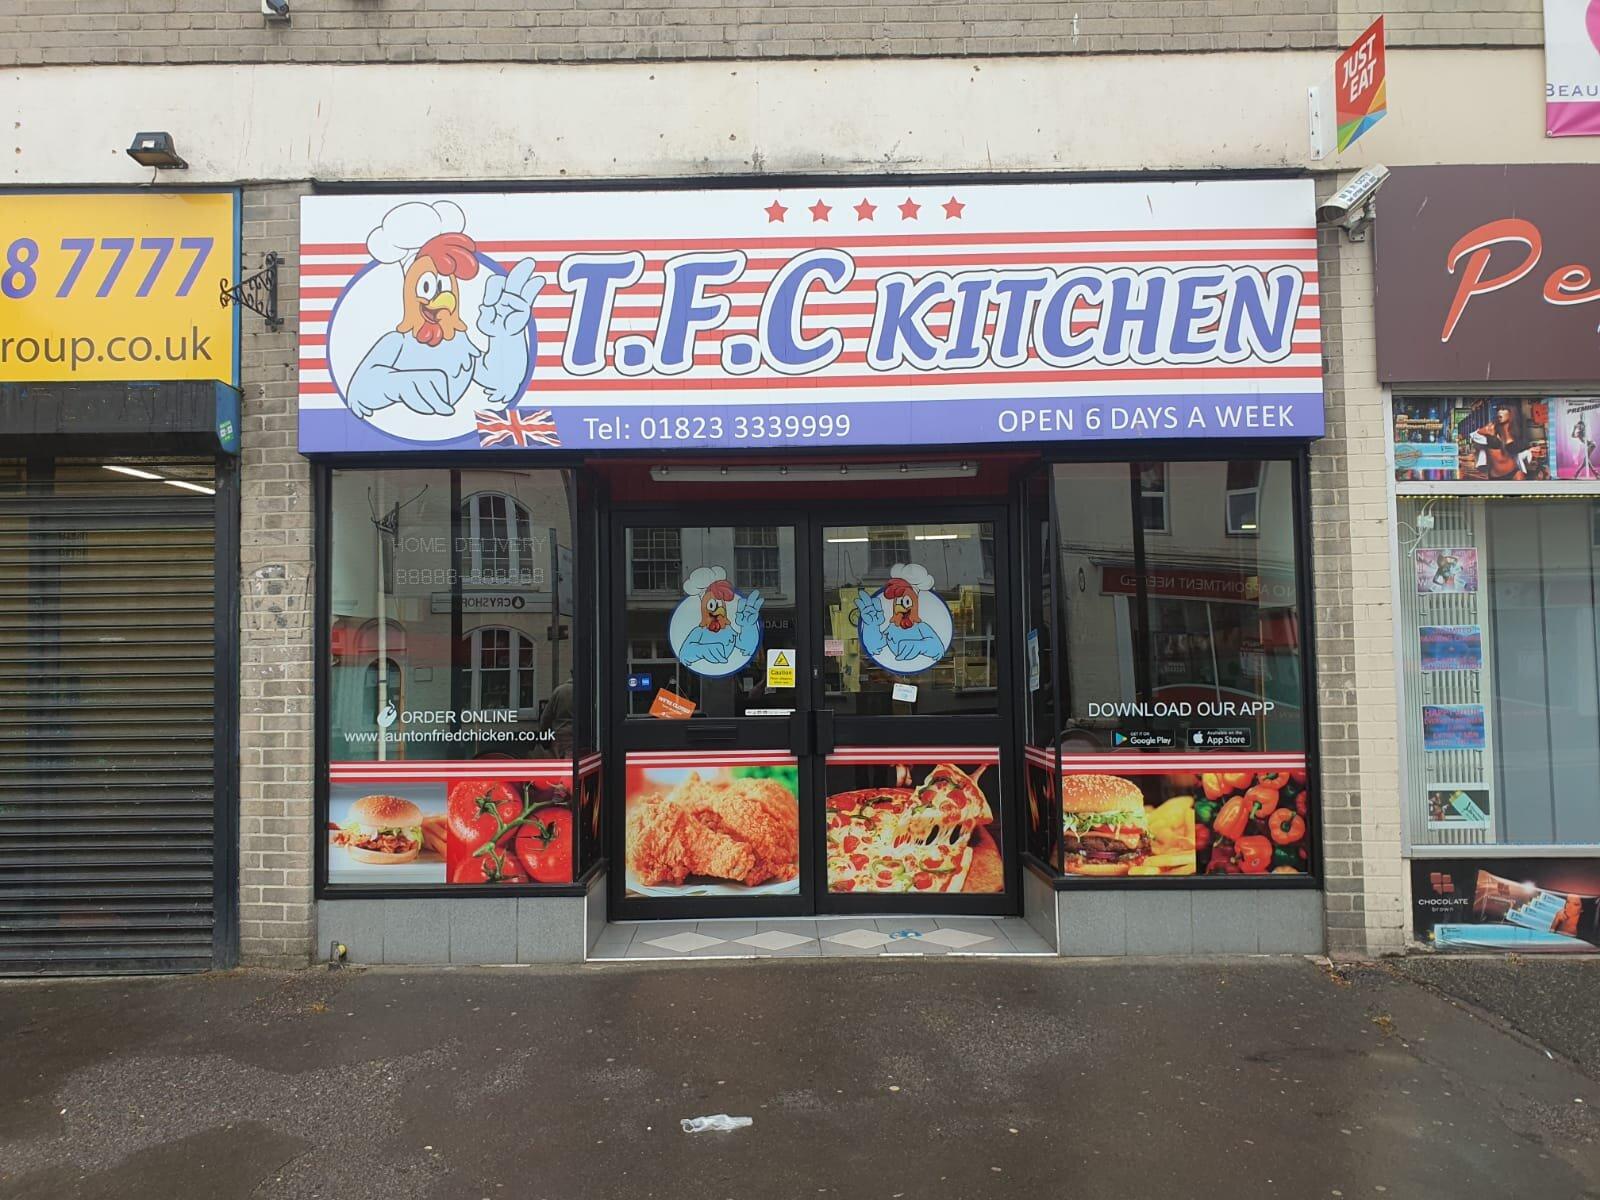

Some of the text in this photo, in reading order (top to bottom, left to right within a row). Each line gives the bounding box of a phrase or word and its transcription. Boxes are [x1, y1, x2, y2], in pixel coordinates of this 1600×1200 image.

[1343, 33, 1376, 88] JUST
[1350, 58, 1377, 103] EAT
[1, 237, 214, 299] 8 7777
[558, 248, 1304, 376] T.F.C KITCHEN
[1, 326, 213, 371] roup.co.uk
[583, 414, 850, 440] Tel: 01823 3339999
[998, 404, 1295, 432] OPEN 6 DAYS A WEEK
[392, 536, 547, 553] HOME DELIVERY
[400, 710, 518, 724] ORDER ONLINE
[1088, 701, 1275, 717] DOWNLOAD OUR APP
[344, 728, 556, 744] www.auntonfriedchicken.co.uk
[1130, 736, 1172, 745] Google Play
[1207, 736, 1246, 745] App Store
